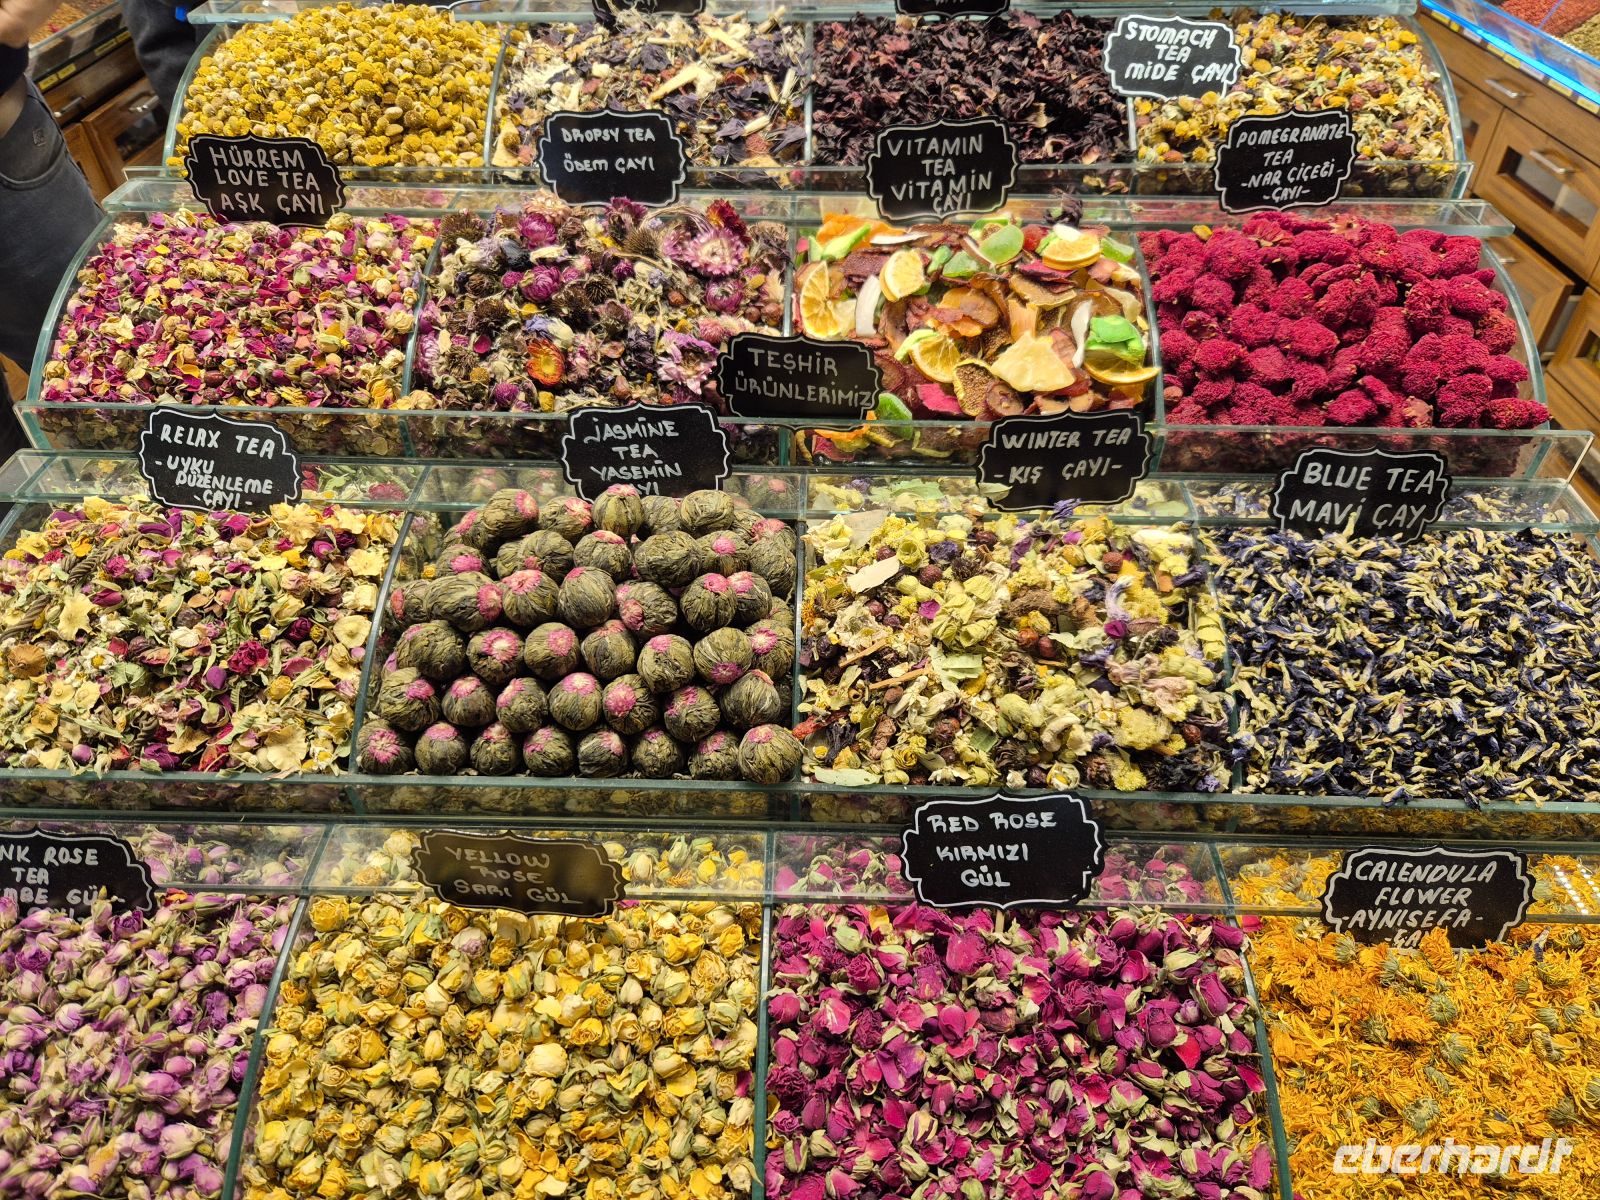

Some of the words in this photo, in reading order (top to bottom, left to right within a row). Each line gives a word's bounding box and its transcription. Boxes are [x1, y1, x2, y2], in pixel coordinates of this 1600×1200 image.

[1124, 21, 1219, 49] STOMACH
[1155, 44, 1192, 63] TEA
[560, 127, 620, 143] DROPSY
[623, 127, 656, 143] TEA
[887, 133, 983, 157] VITAMIN
[1235, 123, 1346, 148] POMEGRANATE
[209, 145, 305, 171] HÜRREM
[563, 152, 609, 173] ÖDEM
[614, 156, 655, 174] ÇAYI
[921, 158, 956, 177] TEA
[1263, 148, 1294, 167] TEA
[214, 168, 269, 187] LOVE
[277, 171, 320, 191] TEA
[220, 191, 265, 214] AŞK
[276, 193, 325, 216] ÇAYI
[932, 192, 972, 215] ÇAYI
[747, 348, 838, 377] TEŞHİR
[735, 370, 872, 408] ÜRÜNLERİMİZ
[160, 423, 221, 449] RELAX
[235, 435, 275, 459] TEA
[1001, 430, 1082, 449] WINTER
[1092, 427, 1132, 447] TEA
[612, 444, 659, 460] TEA
[175, 470, 273, 495] DÜZENLEME
[1303, 462, 1373, 490] BLUE
[1386, 467, 1435, 494] TEA
[1372, 503, 1427, 530] ÇAY
[926, 814, 980, 833] RED
[989, 811, 1057, 830] ROSE
[0, 843, 31, 864] NK
[43, 846, 99, 867] ROSE
[445, 846, 551, 869] YELLOW
[936, 842, 1029, 862] KIRMIZI
[11, 867, 49, 886] TEA
[470, 865, 545, 884] ROSE
[960, 864, 1011, 888] GÜL
[1355, 860, 1498, 884] CALENDULA
[2, 886, 49, 905] MBE
[453, 879, 512, 898] SARI
[526, 886, 584, 904] GÜL
[1374, 886, 1473, 907] FLOWER
